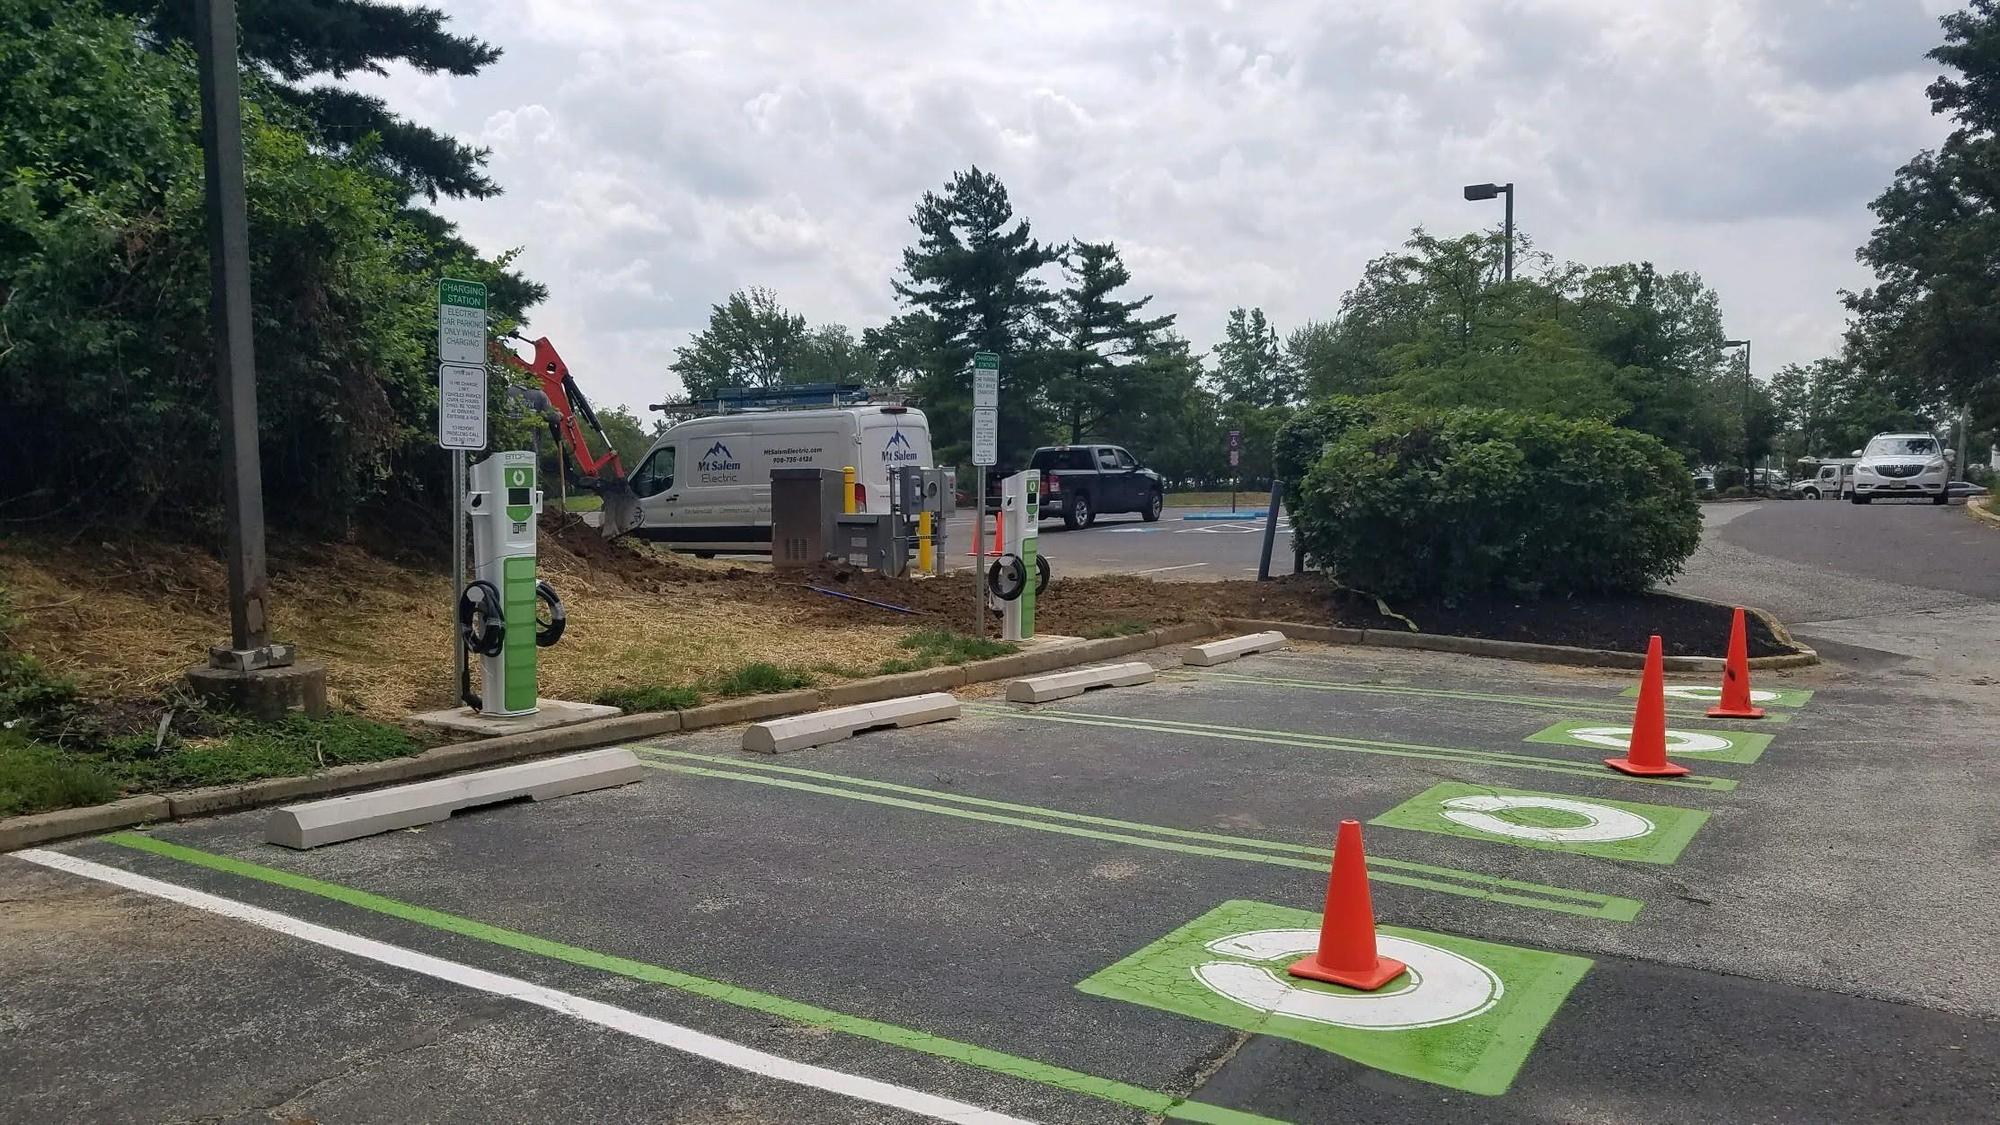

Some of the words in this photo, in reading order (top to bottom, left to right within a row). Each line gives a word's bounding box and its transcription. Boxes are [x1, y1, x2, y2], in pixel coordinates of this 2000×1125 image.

[442, 283, 484, 296] CHARGING
[447, 294, 481, 306] STATION
[448, 308, 478, 318] ELECTRIC
[444, 327, 460, 336] ONLY
[446, 336, 480, 347] CHARGING
[882, 451, 893, 461] Mt
[894, 450, 917, 460] Salem
[697, 461, 710, 471] Mt
[711, 460, 741, 470] Salem
[701, 473, 738, 482] Electric
